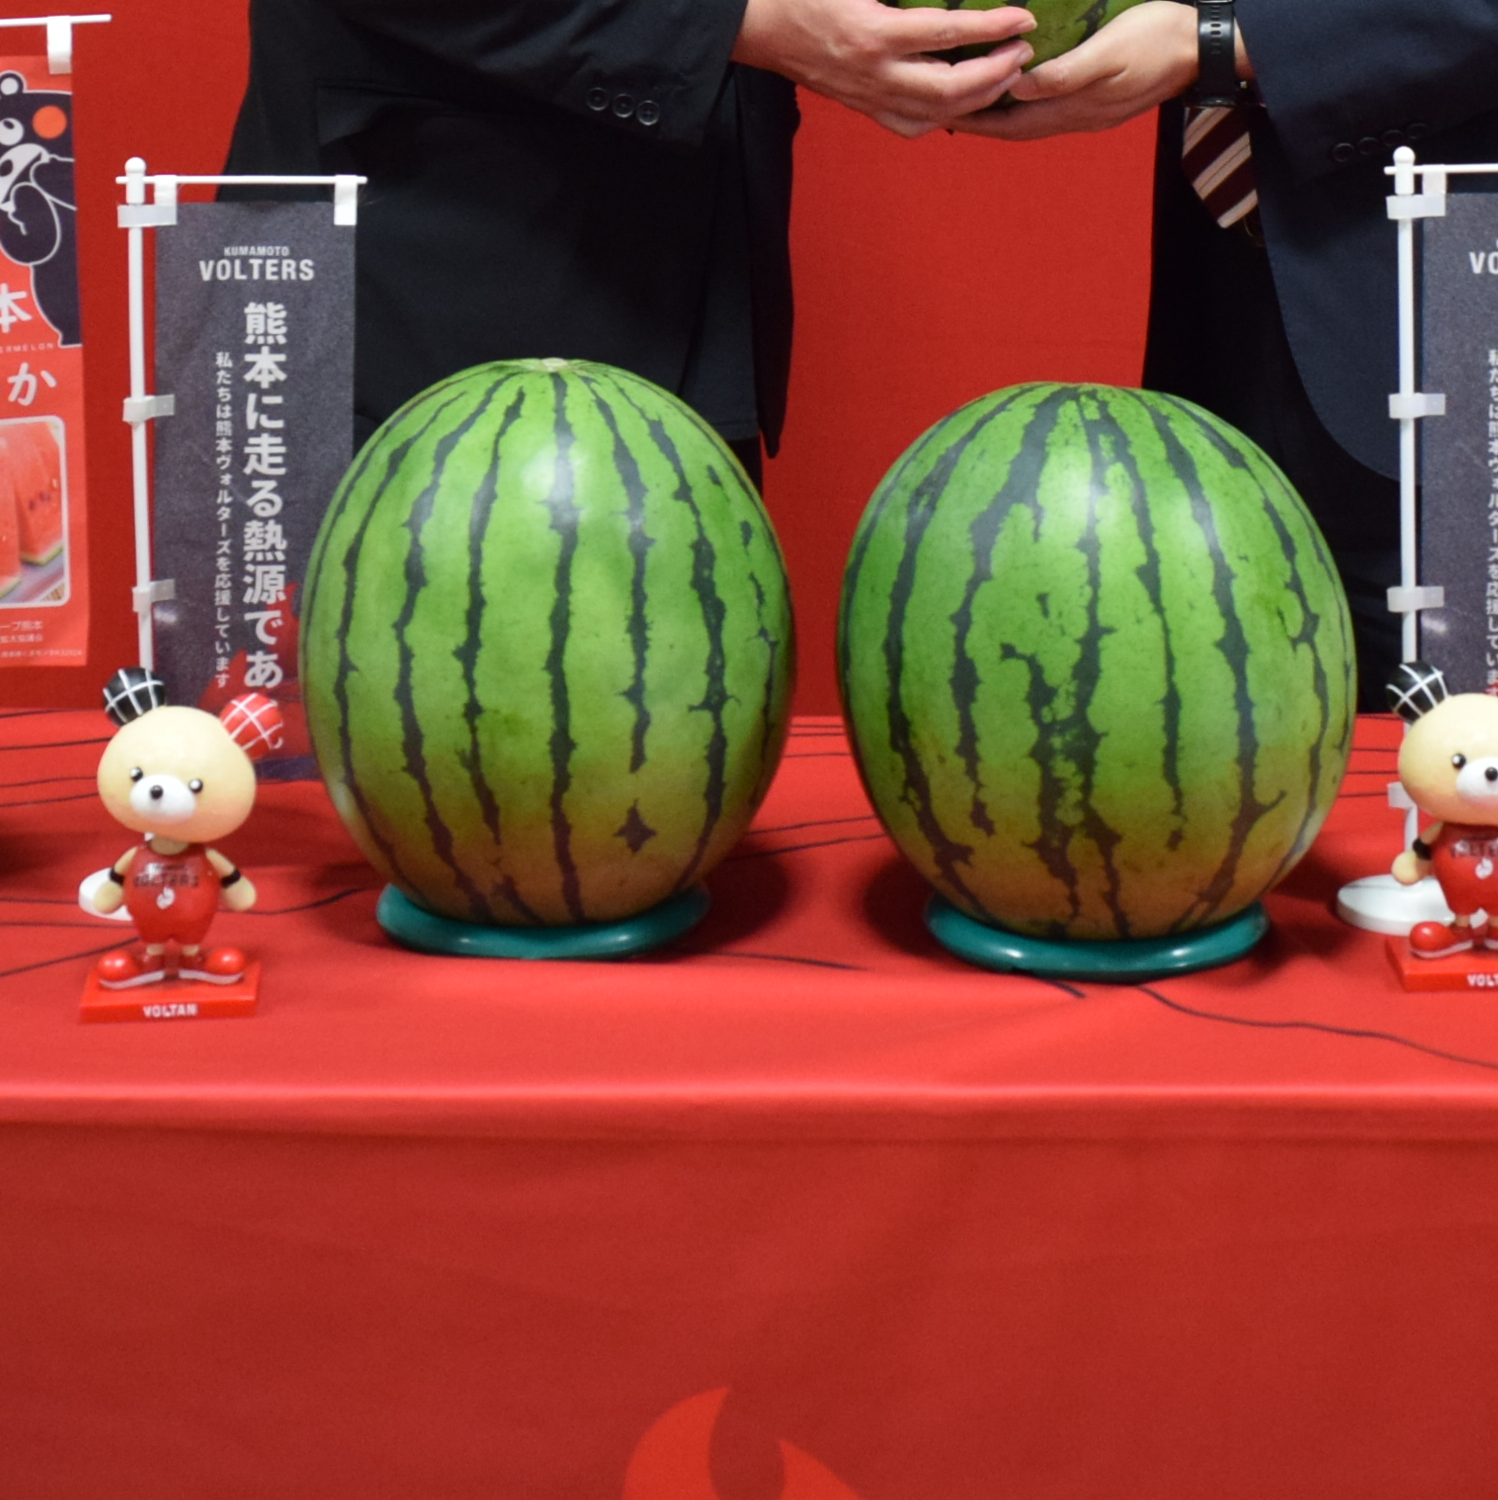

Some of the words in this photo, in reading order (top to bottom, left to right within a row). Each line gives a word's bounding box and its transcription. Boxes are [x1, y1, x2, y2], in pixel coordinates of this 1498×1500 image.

[224, 246, 290, 257] KUMAMOTO
[199, 258, 315, 281] VOLTERS
[214, 352, 233, 688] 私たちは熊本ヴォルターズを応援しています
[243, 302, 288, 750] 熊本に走る熱源であ
[143, 1003, 198, 1018] VOLTAN
